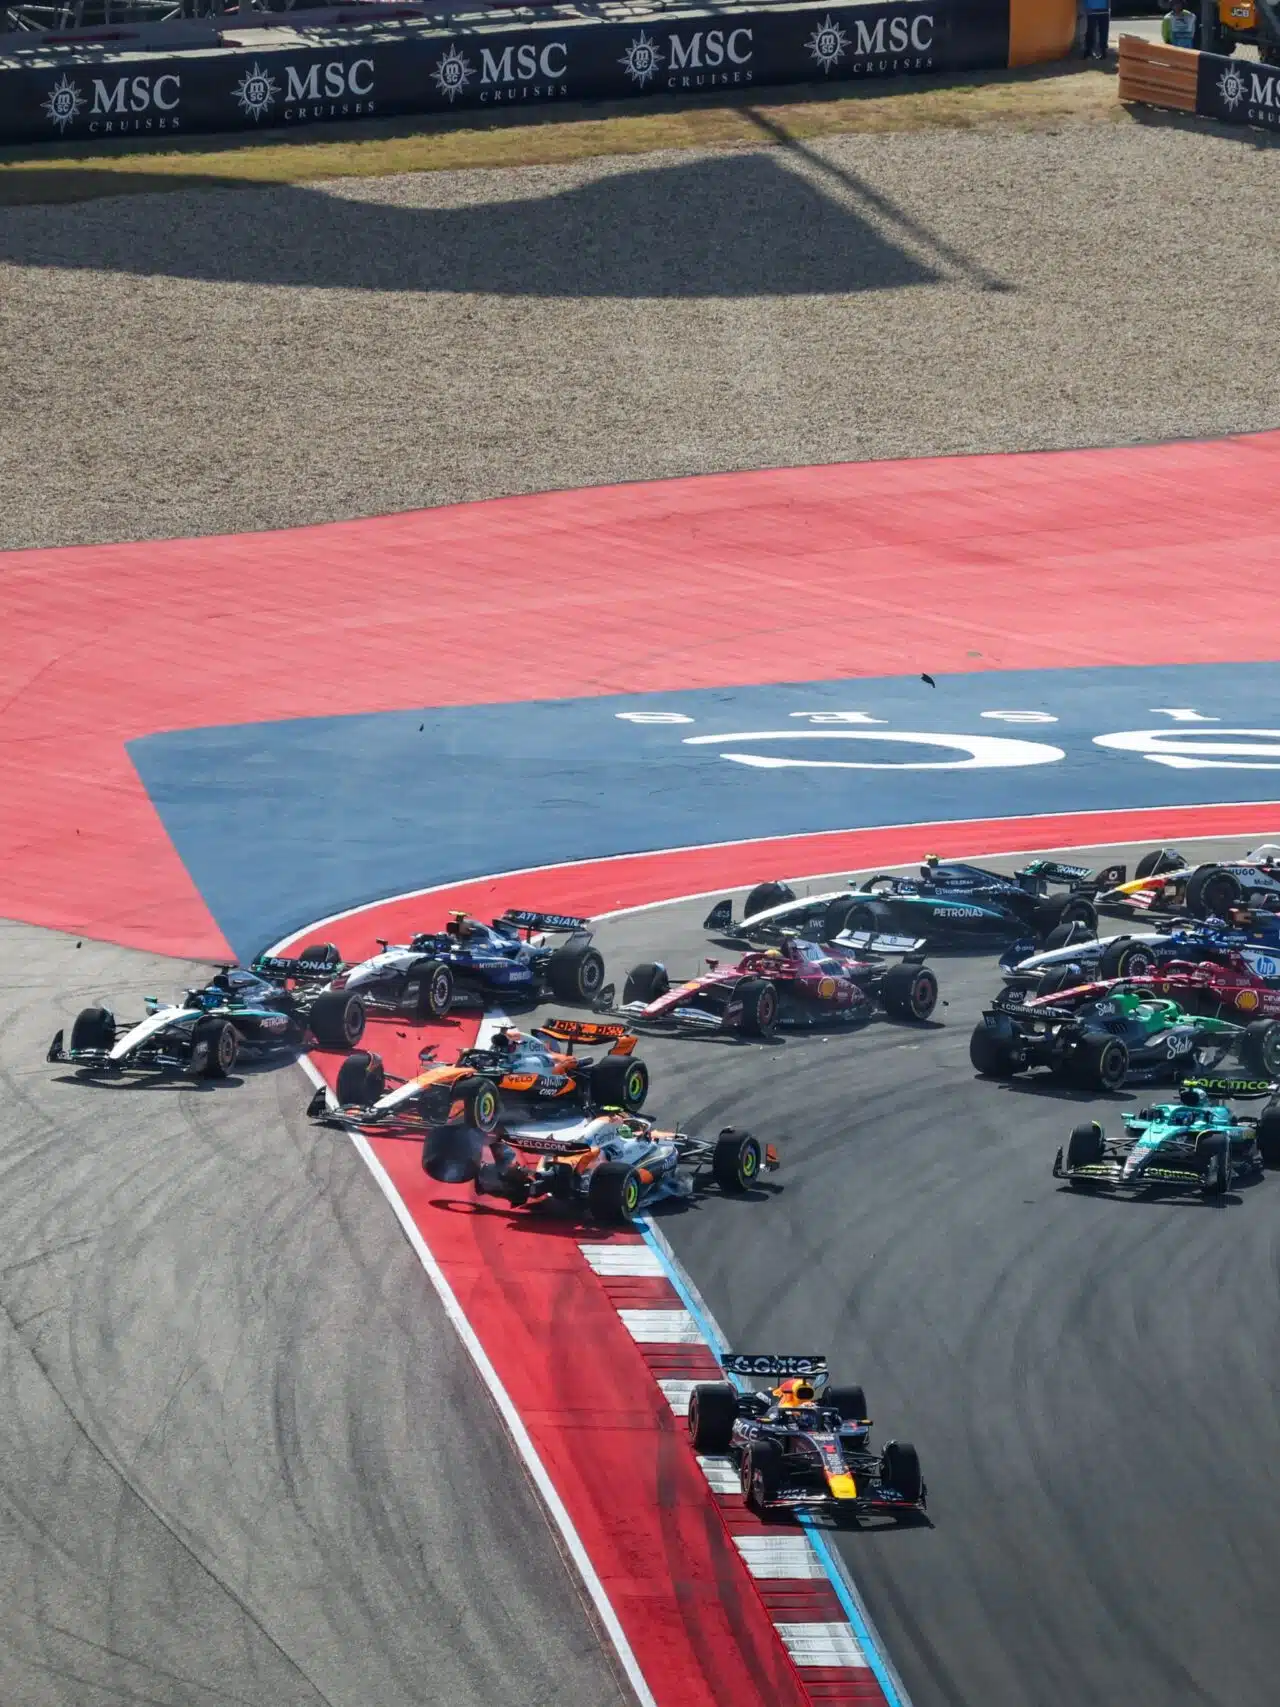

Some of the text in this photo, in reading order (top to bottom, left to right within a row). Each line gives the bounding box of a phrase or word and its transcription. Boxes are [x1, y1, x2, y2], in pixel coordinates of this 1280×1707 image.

[854, 15, 933, 55] MSC
[668, 29, 753, 70] MSC
[480, 43, 567, 84] MSC
[853, 58, 932, 73] CRUISES
[284, 60, 375, 102] MSC
[668, 71, 752, 88] CRUISES
[90, 75, 180, 114] MSC
[480, 85, 567, 102] CRUISES
[284, 101, 374, 120] CRUISES
[89, 117, 180, 133] CRUISES
[517, 910, 580, 927] ATSSIAN
[933, 907, 984, 918] PETRONAS
[809, 918, 825, 928] IWC
[269, 957, 333, 971] PETONAS
[1257, 956, 1275, 978] hp
[1008, 991, 1024, 1000] aws
[1005, 1003, 1057, 1018] COINPAYMENTS
[1197, 1078, 1268, 1090] aramco
[517, 1139, 569, 1152] VELO.COM
